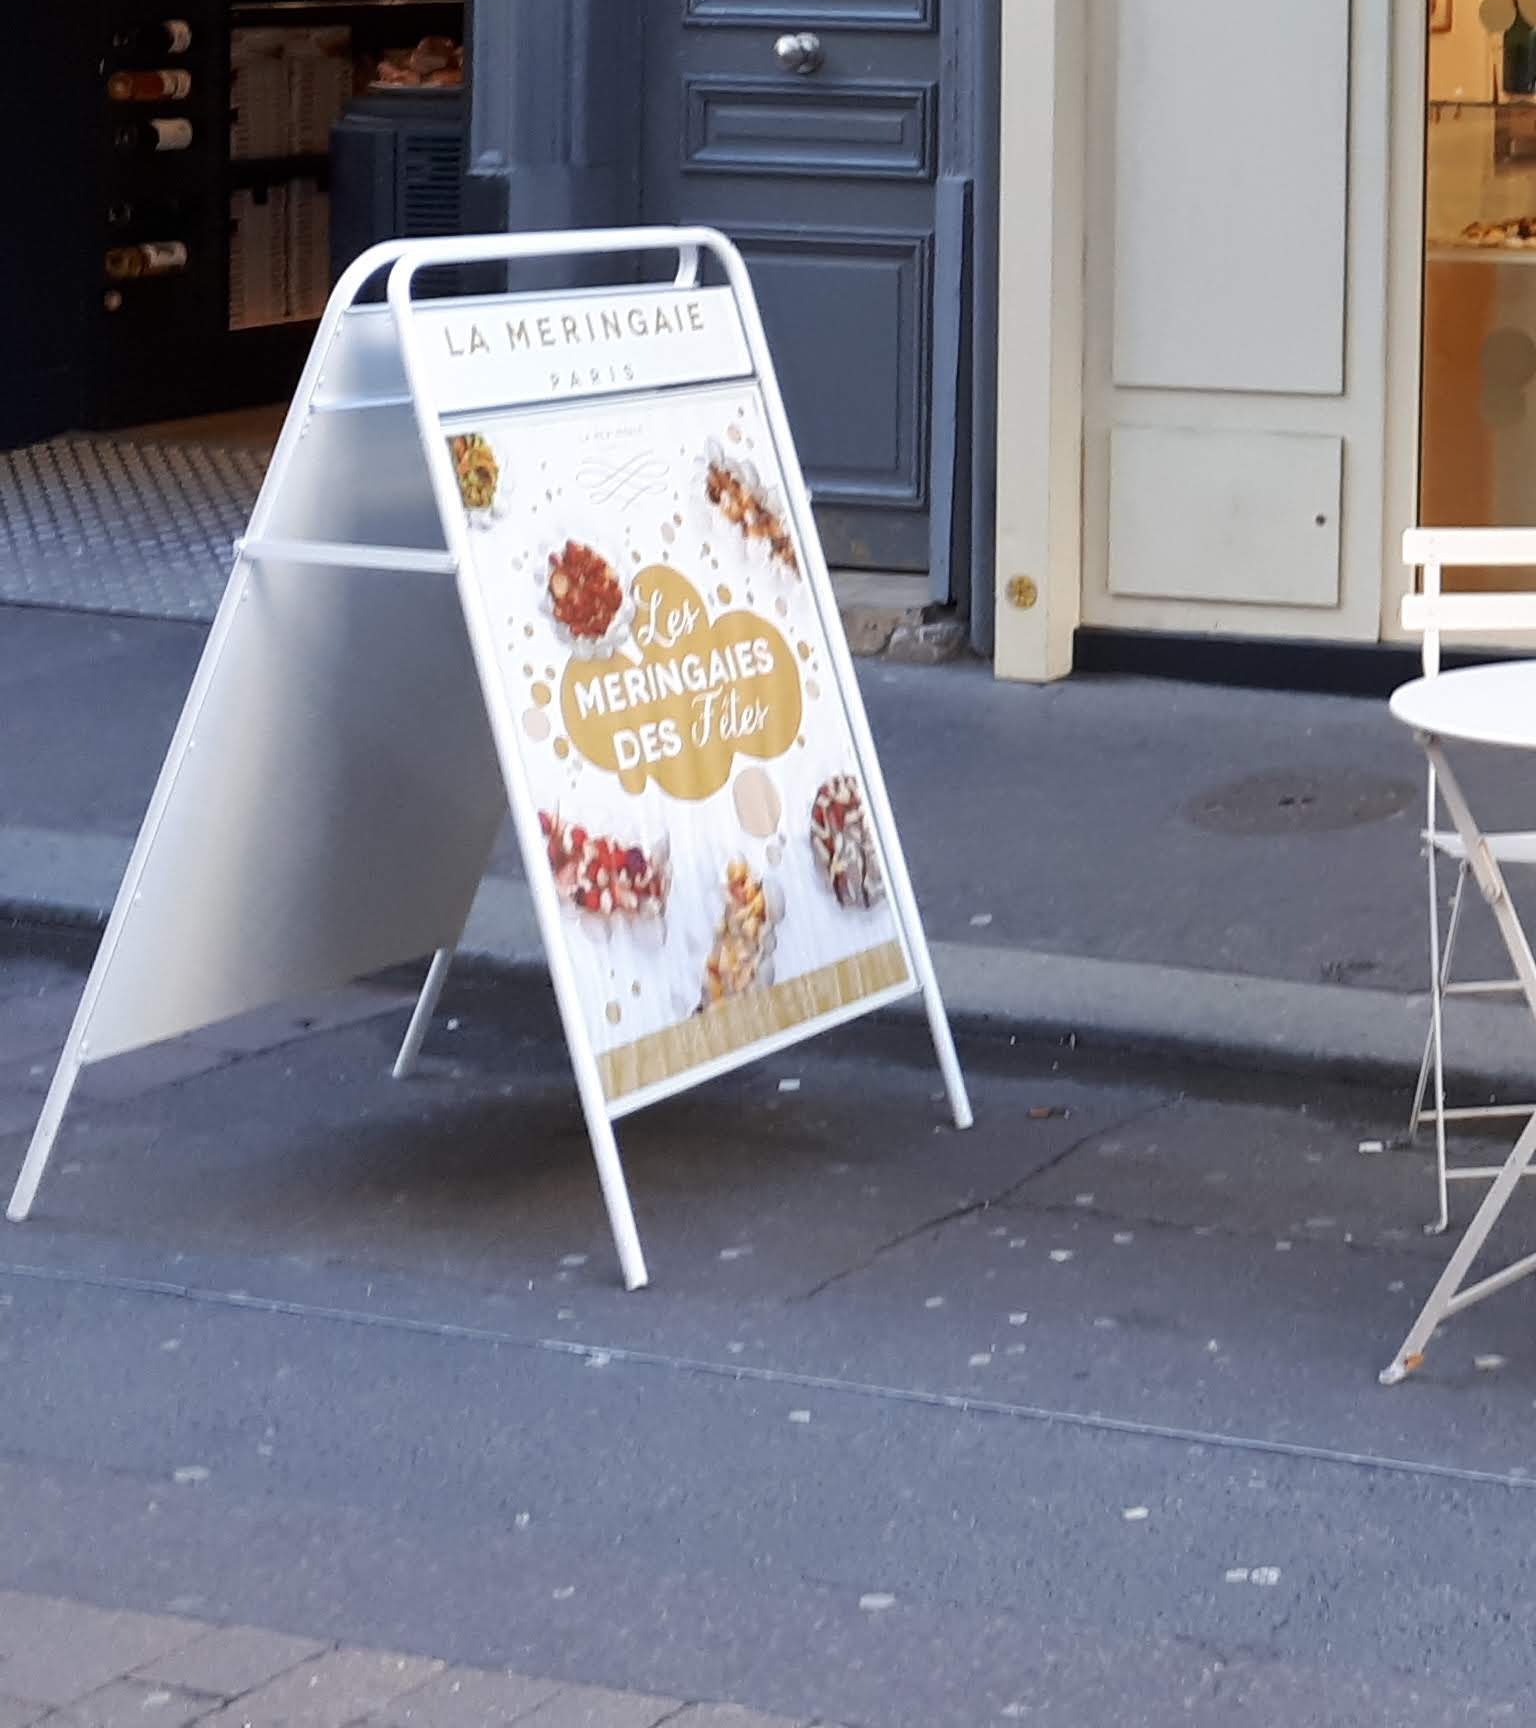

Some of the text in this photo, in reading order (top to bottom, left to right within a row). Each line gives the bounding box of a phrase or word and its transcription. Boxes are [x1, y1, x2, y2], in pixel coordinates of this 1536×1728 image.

[444, 302, 705, 357] LA MERINGAIE
[549, 363, 635, 391] PARIS
[633, 585, 700, 648] Les
[574, 637, 775, 720] MERINGAIES
[613, 718, 683, 771] DES
